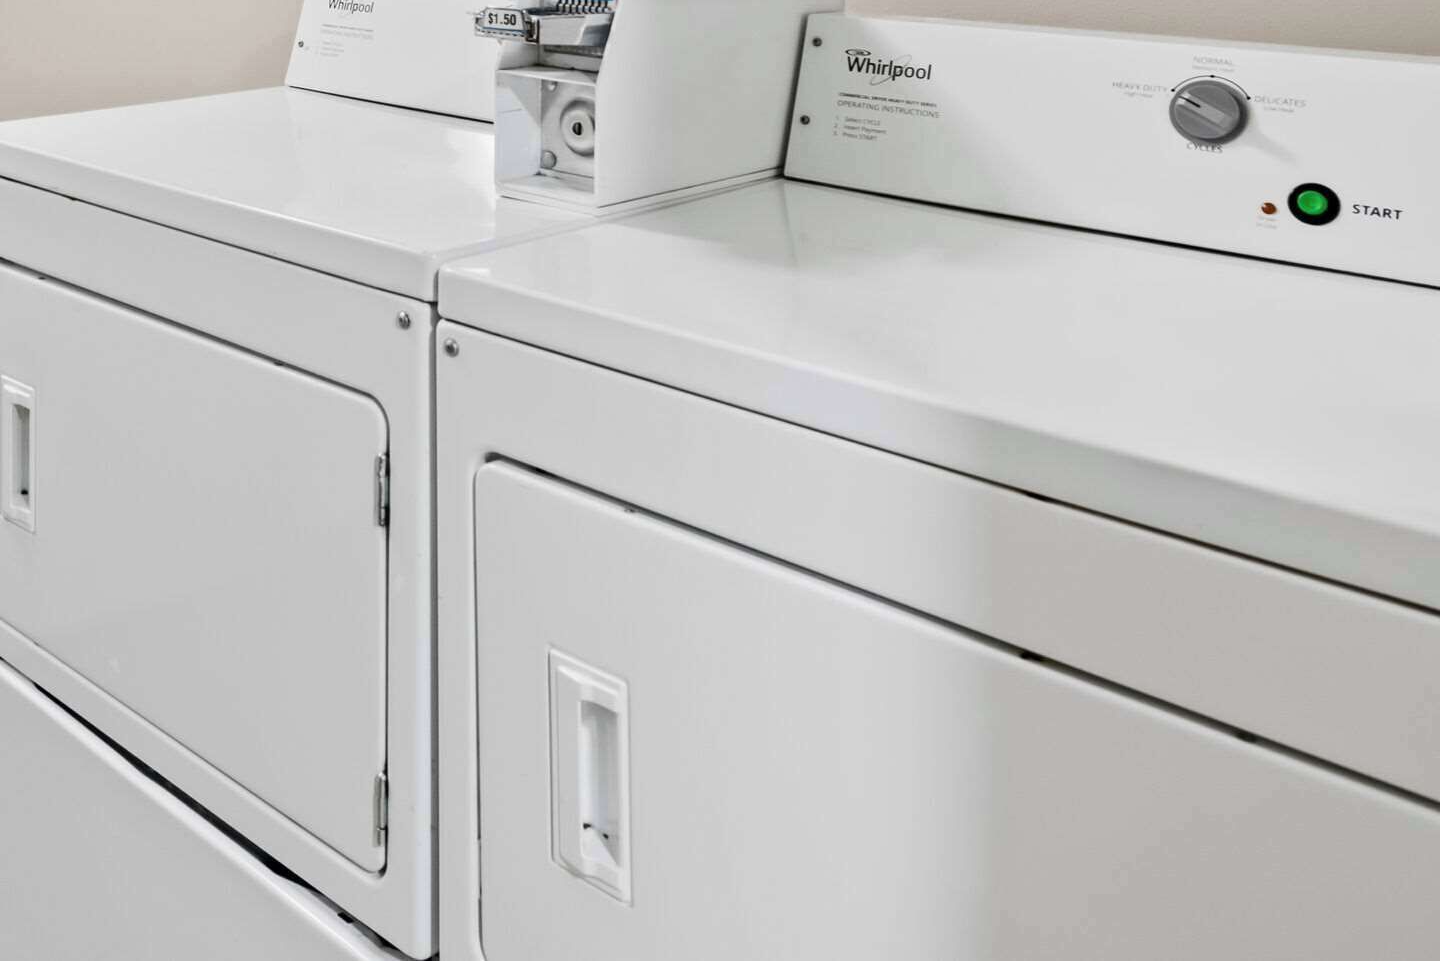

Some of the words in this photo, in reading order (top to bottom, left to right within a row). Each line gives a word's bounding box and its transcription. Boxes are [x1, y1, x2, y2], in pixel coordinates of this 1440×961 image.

[487, 12, 517, 26] $1.50
[1192, 55, 1234, 67] NORMAL
[847, 55, 933, 82] Whirlpool
[1253, 94, 1307, 108] DELICATES
[836, 99, 880, 111] OPERATING
[881, 104, 941, 119] INSTRUCTIONS
[1186, 142, 1224, 154] CYCLES
[1351, 203, 1404, 220] START
